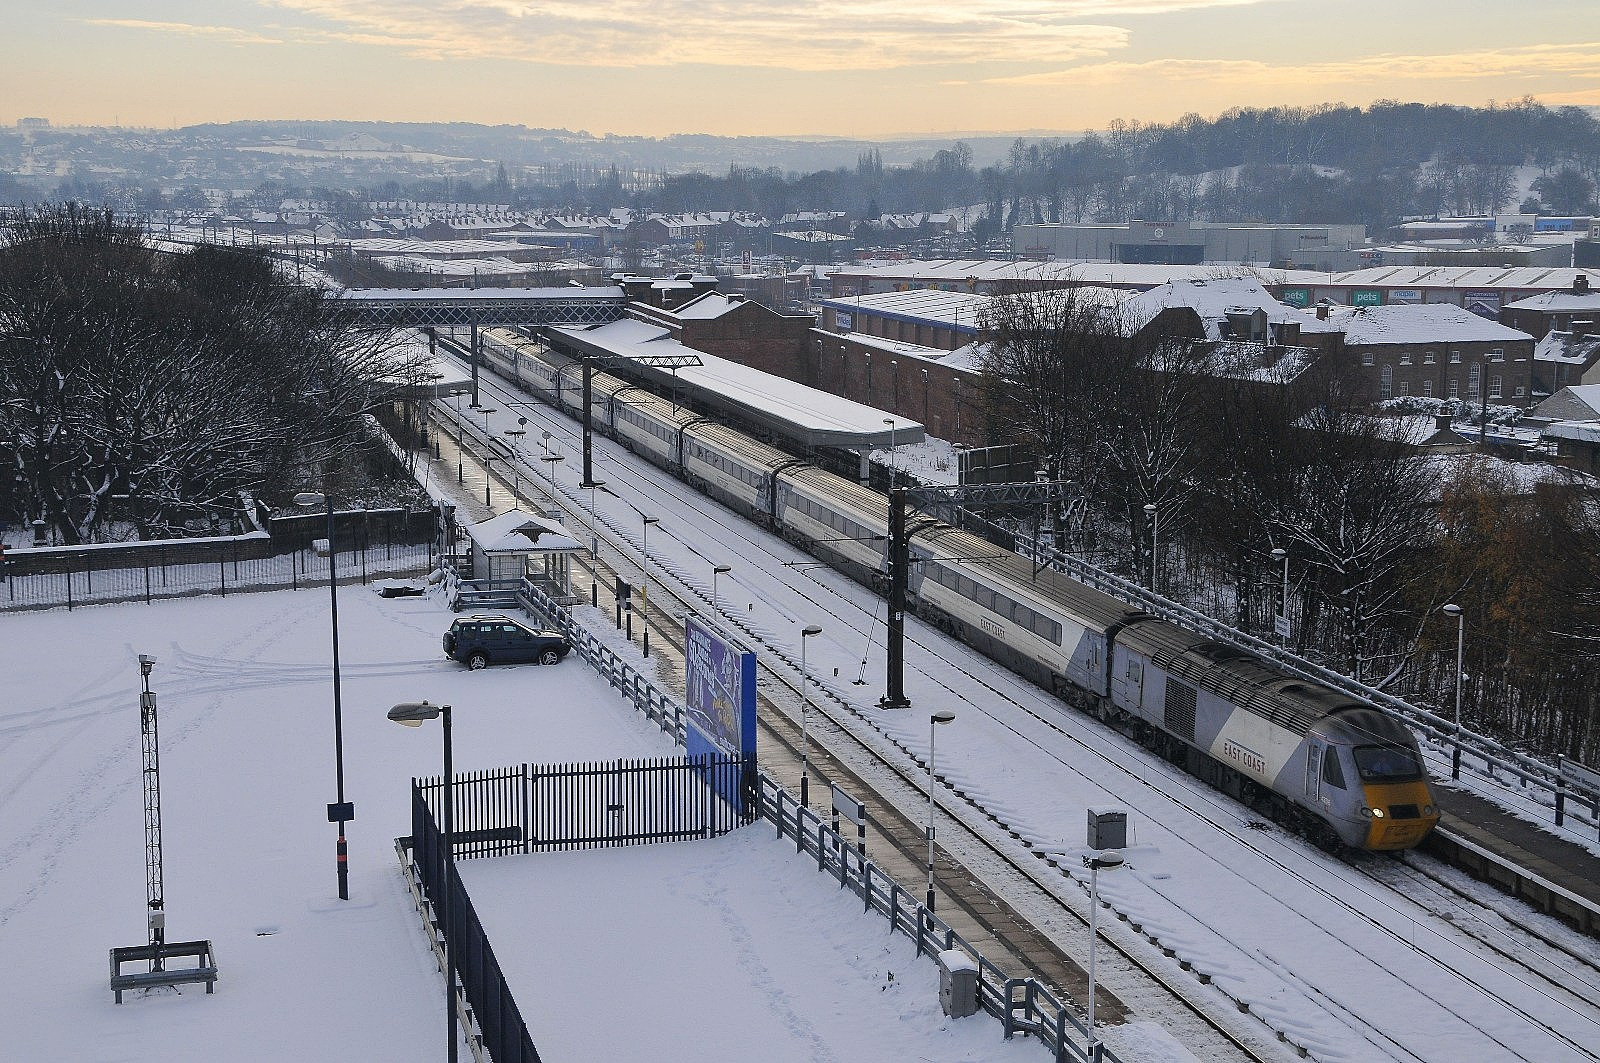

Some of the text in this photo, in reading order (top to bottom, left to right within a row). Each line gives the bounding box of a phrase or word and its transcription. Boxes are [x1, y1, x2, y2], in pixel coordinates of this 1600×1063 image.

[1284, 290, 1304, 301] pets
[1357, 292, 1377, 303] pets
[980, 618, 991, 632] EAST
[1224, 742, 1266, 775] EAST COAST
